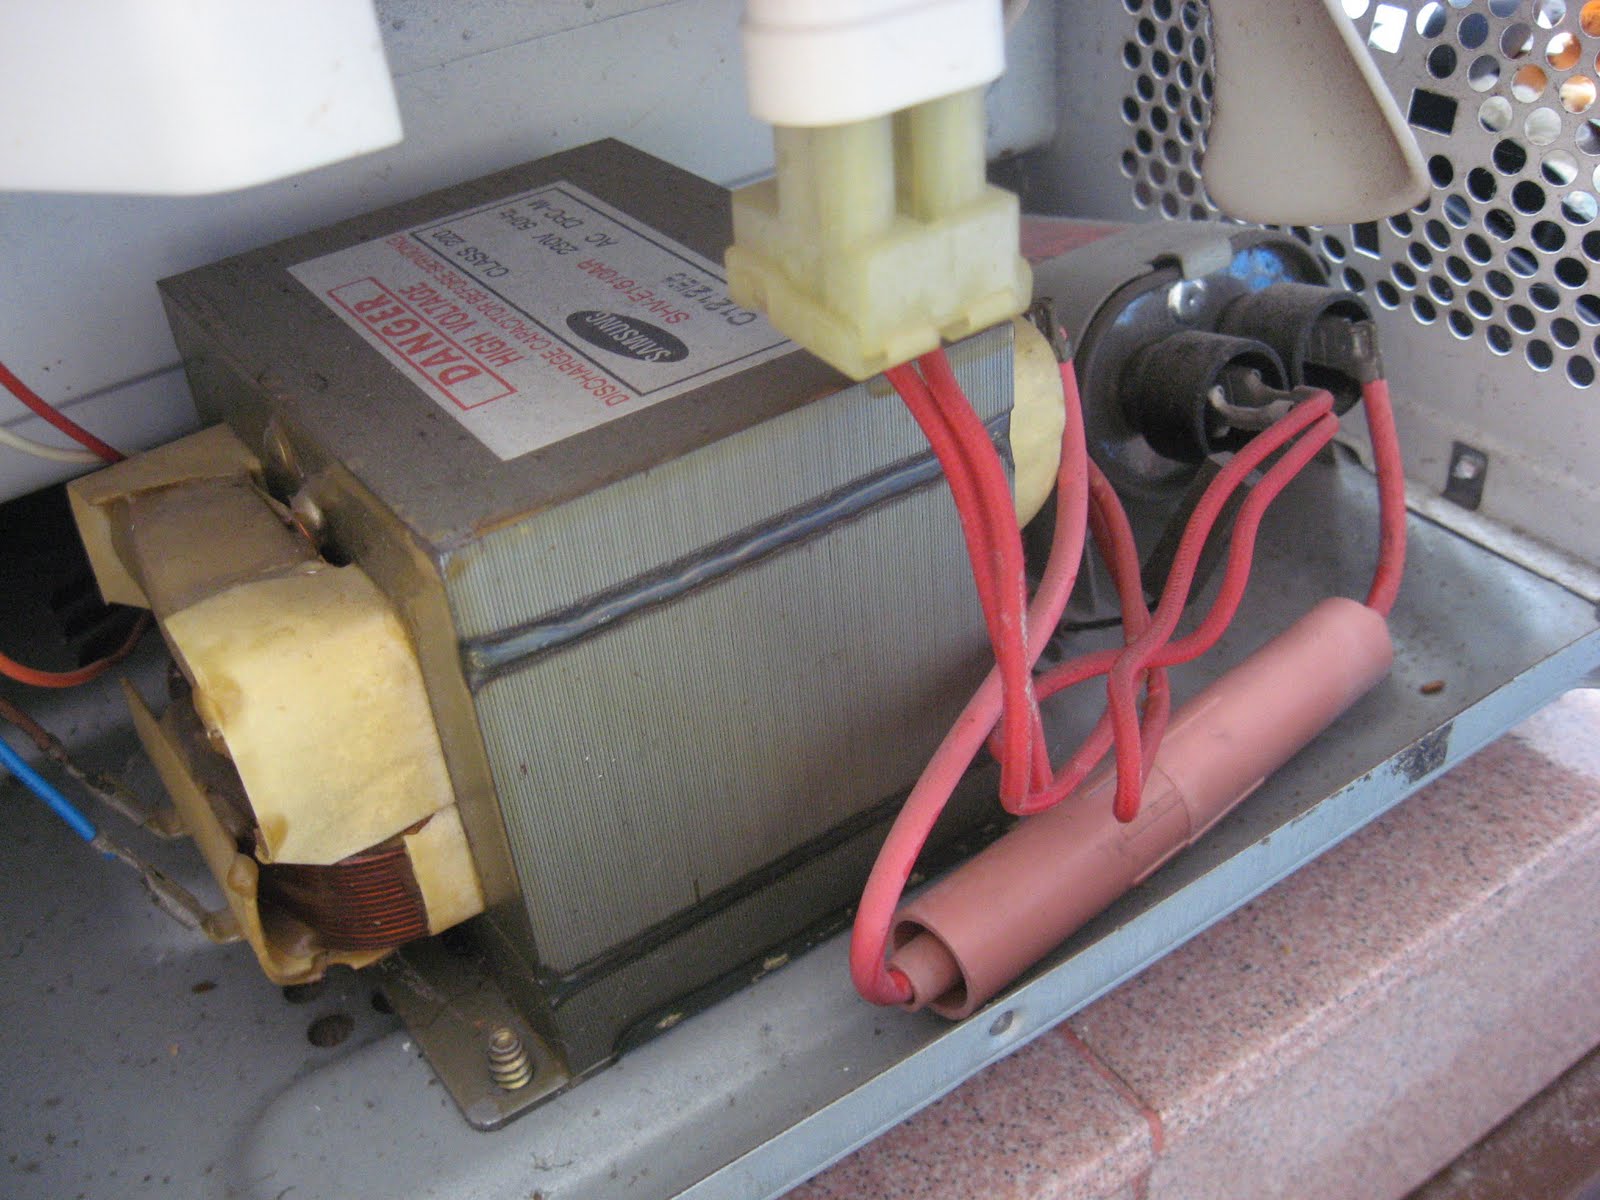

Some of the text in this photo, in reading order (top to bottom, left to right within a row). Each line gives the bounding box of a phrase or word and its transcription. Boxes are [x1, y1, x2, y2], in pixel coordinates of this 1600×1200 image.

[432, 230, 509, 277] CLASS 220
[532, 233, 578, 255] 230V
[585, 234, 618, 247] AC
[433, 271, 488, 304] BEFORE
[354, 294, 481, 385] DANGER
[398, 282, 524, 367] HIGH VOLTAGE
[476, 301, 552, 350] CAPACITOR
[586, 309, 671, 364] SAMSUNG
[540, 347, 629, 406] DISCHARGE
